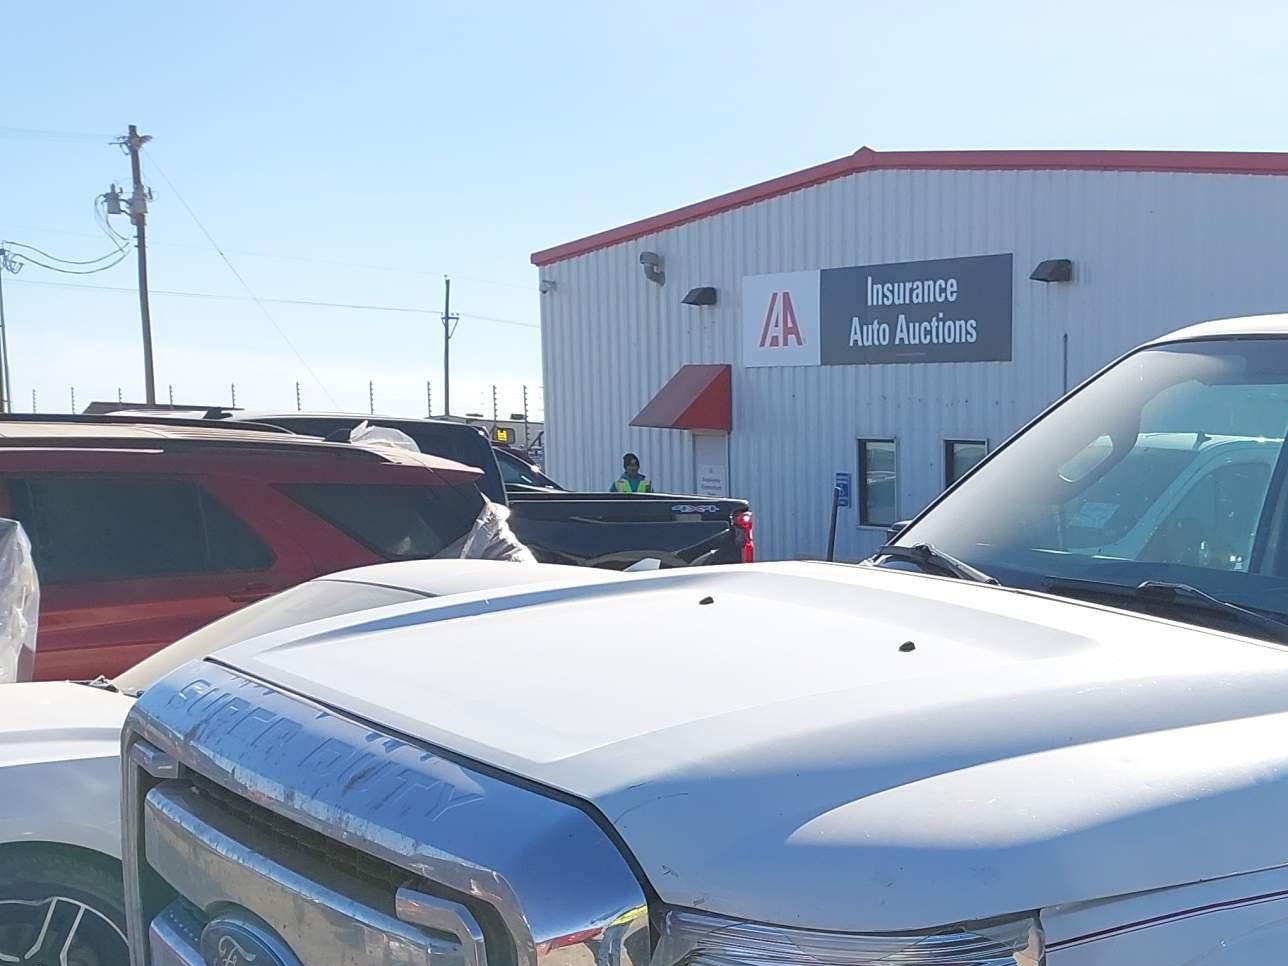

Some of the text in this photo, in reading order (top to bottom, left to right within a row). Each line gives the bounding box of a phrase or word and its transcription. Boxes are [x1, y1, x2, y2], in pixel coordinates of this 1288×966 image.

[866, 276, 958, 307] Insurance
[849, 311, 977, 347] Auto Auctions
[167, 678, 487, 823] SUPER DUTY
